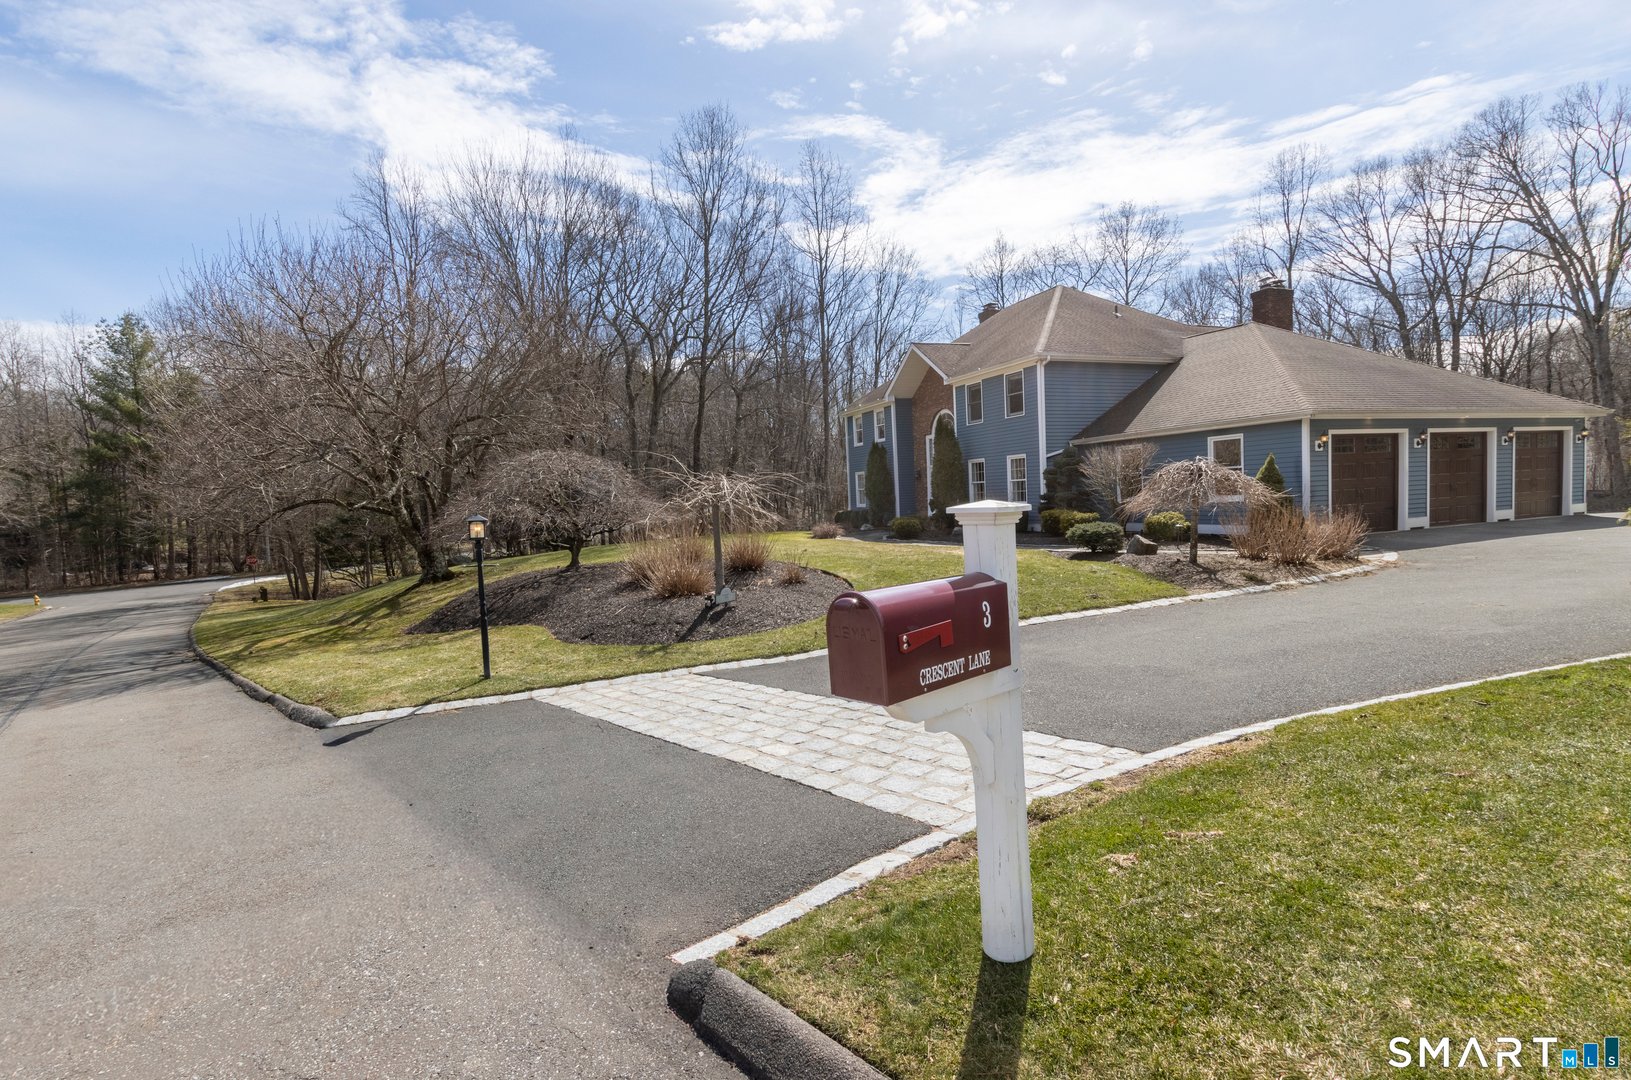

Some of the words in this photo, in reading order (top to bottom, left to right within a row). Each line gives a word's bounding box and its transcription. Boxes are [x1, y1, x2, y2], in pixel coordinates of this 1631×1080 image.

[982, 601, 992, 628] 3
[919, 657, 965, 686] CRESCENT
[968, 650, 991, 671] LANE
